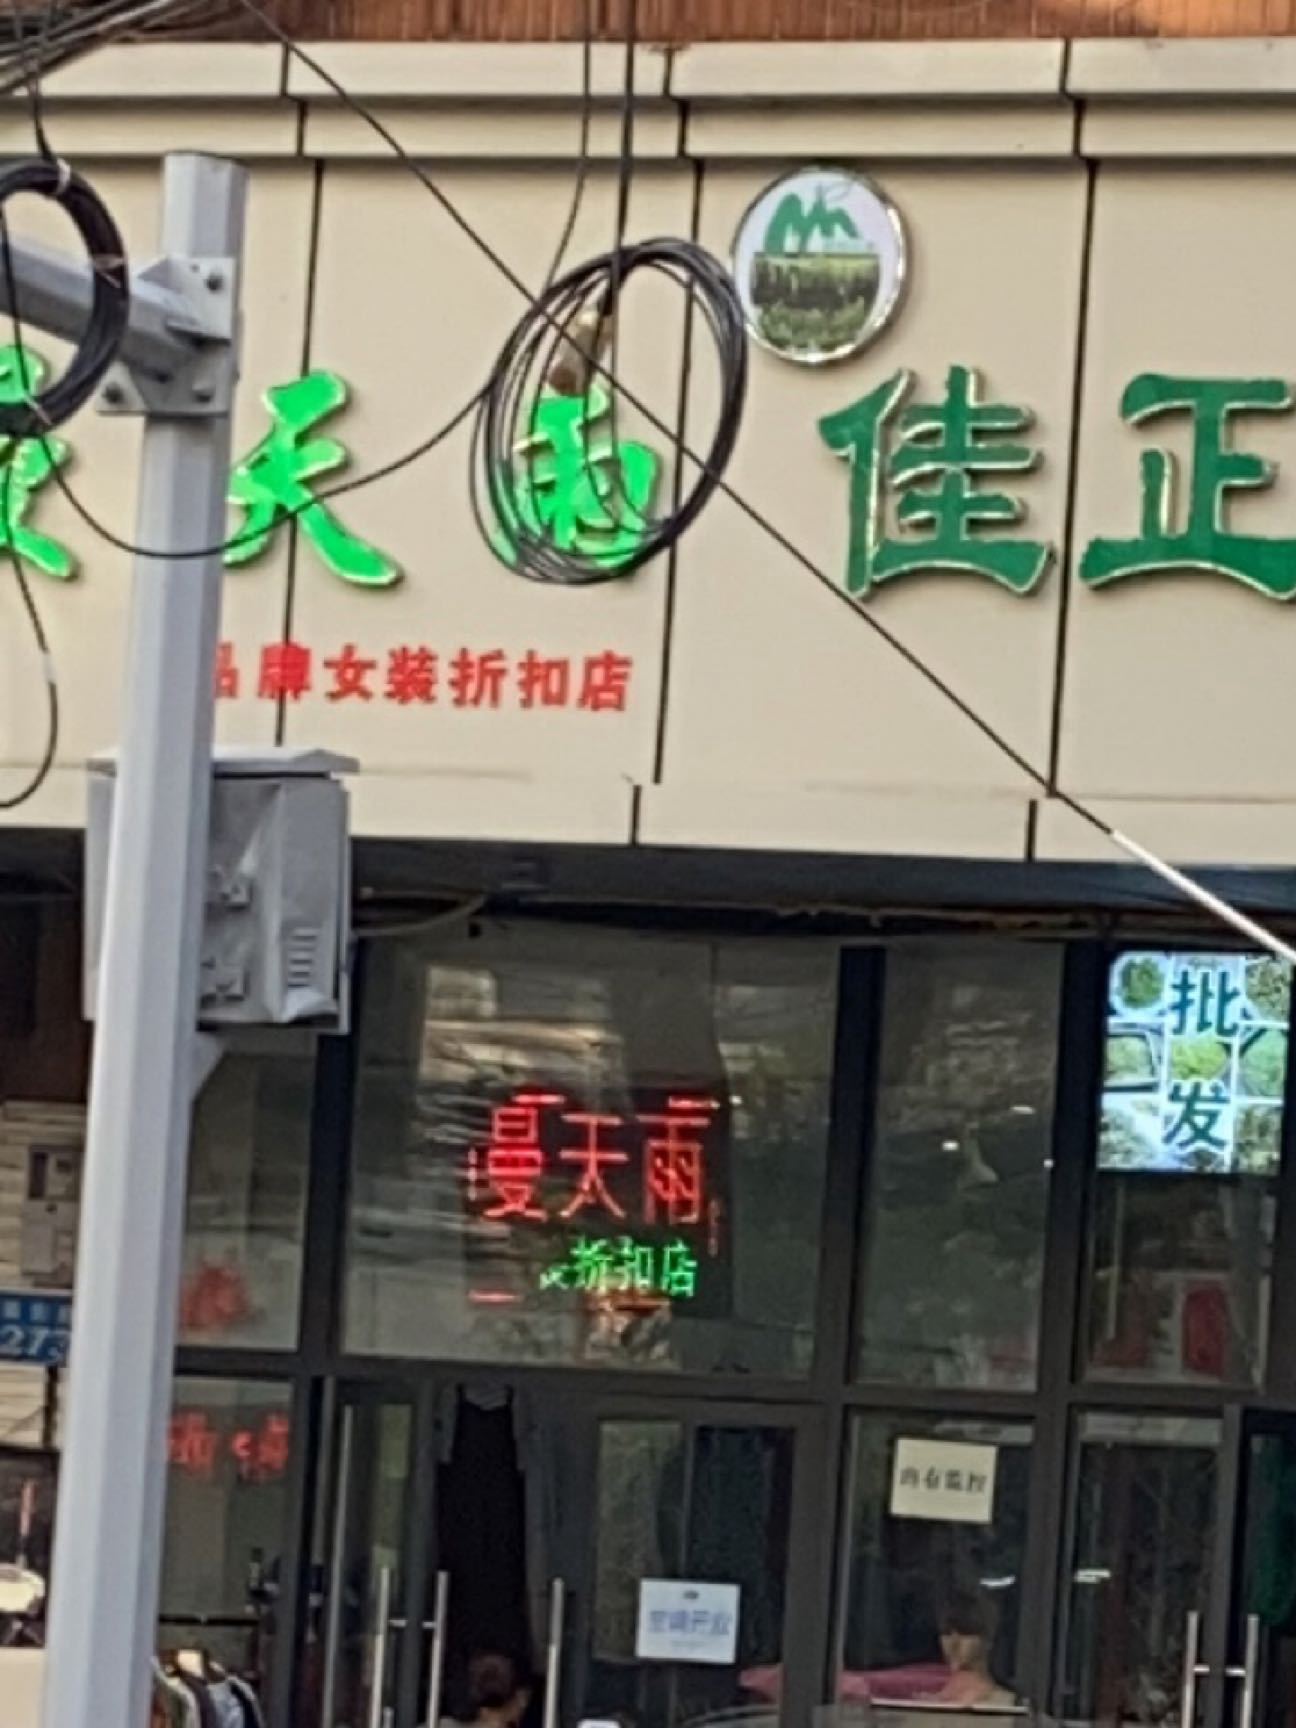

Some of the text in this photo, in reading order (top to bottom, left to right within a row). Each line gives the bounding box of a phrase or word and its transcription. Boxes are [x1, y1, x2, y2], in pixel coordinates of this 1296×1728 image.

[1162, 967, 1240, 1150] 批发
[483, 1105, 711, 1225] 曼天雨
